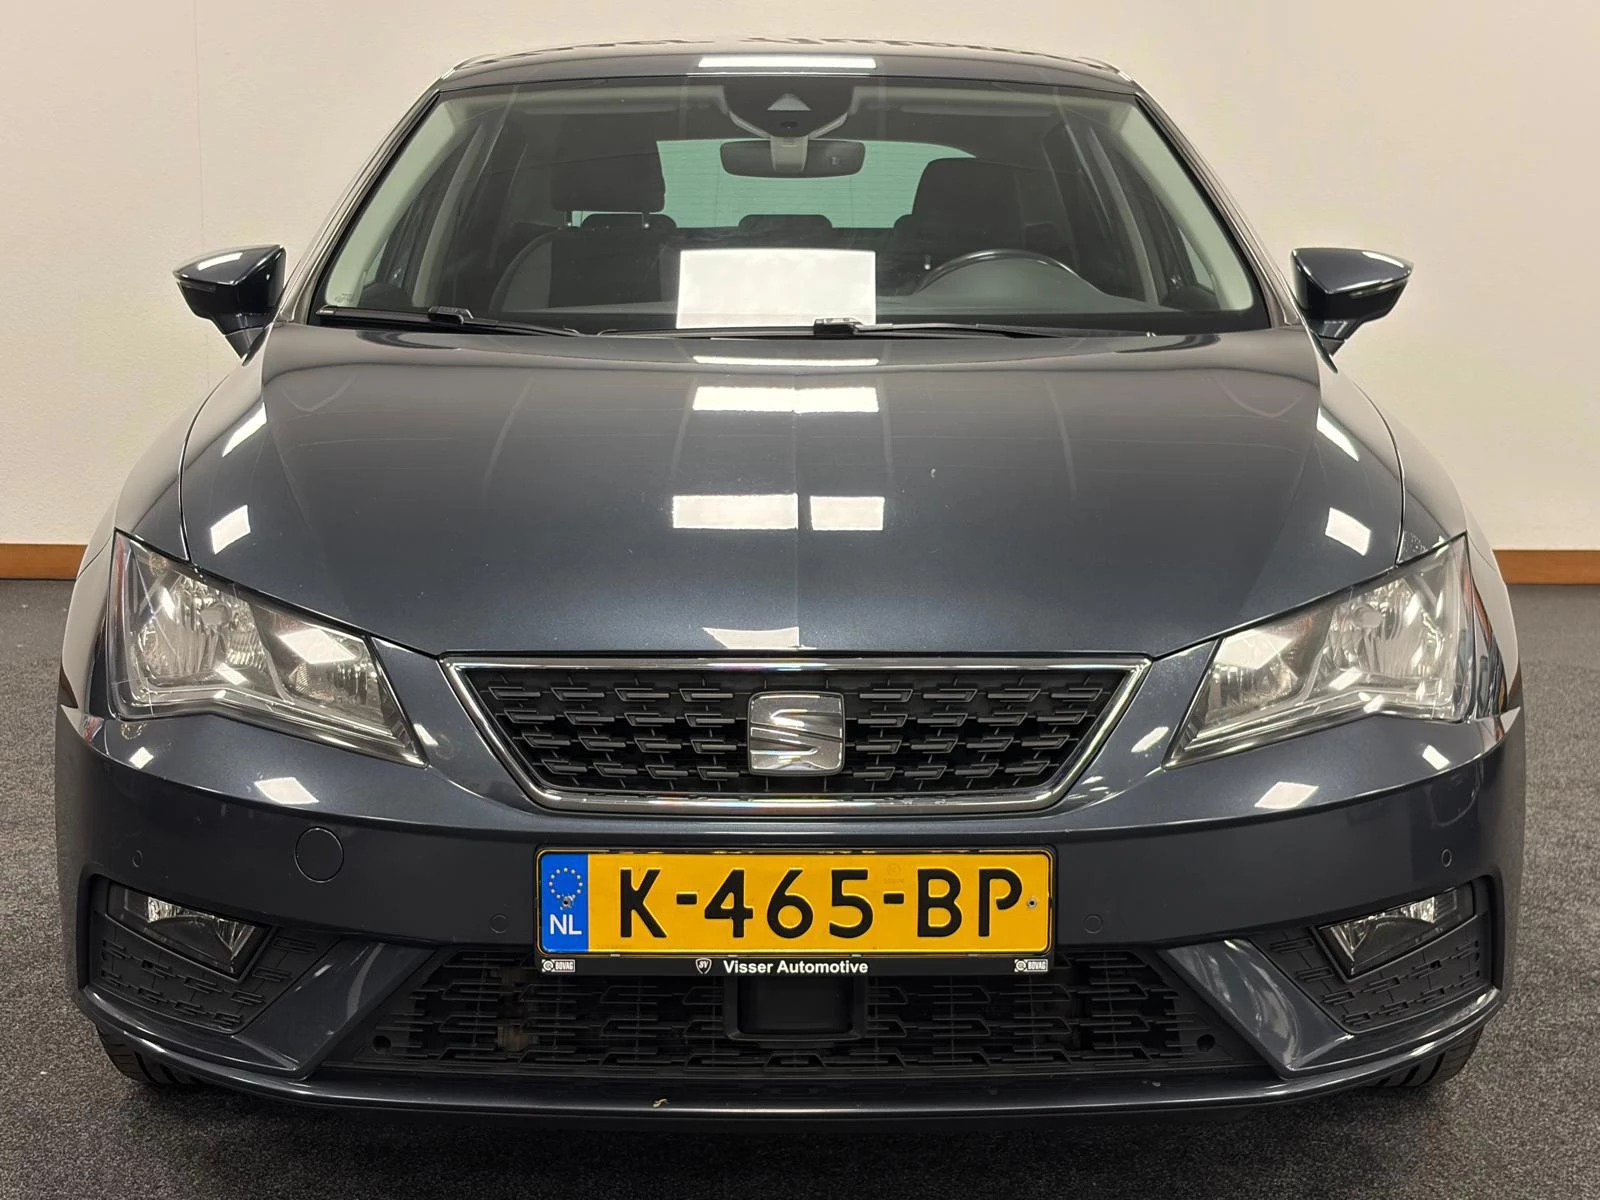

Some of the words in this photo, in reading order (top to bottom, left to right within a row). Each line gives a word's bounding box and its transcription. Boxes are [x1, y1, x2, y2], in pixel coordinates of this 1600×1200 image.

[620, 868, 1023, 939] K-465-BP
[549, 913, 583, 935] NL
[555, 961, 574, 971] BOVAG
[723, 960, 773, 974] Visser
[777, 960, 869, 974] Automotive
[1027, 961, 1046, 970] BOVAG
